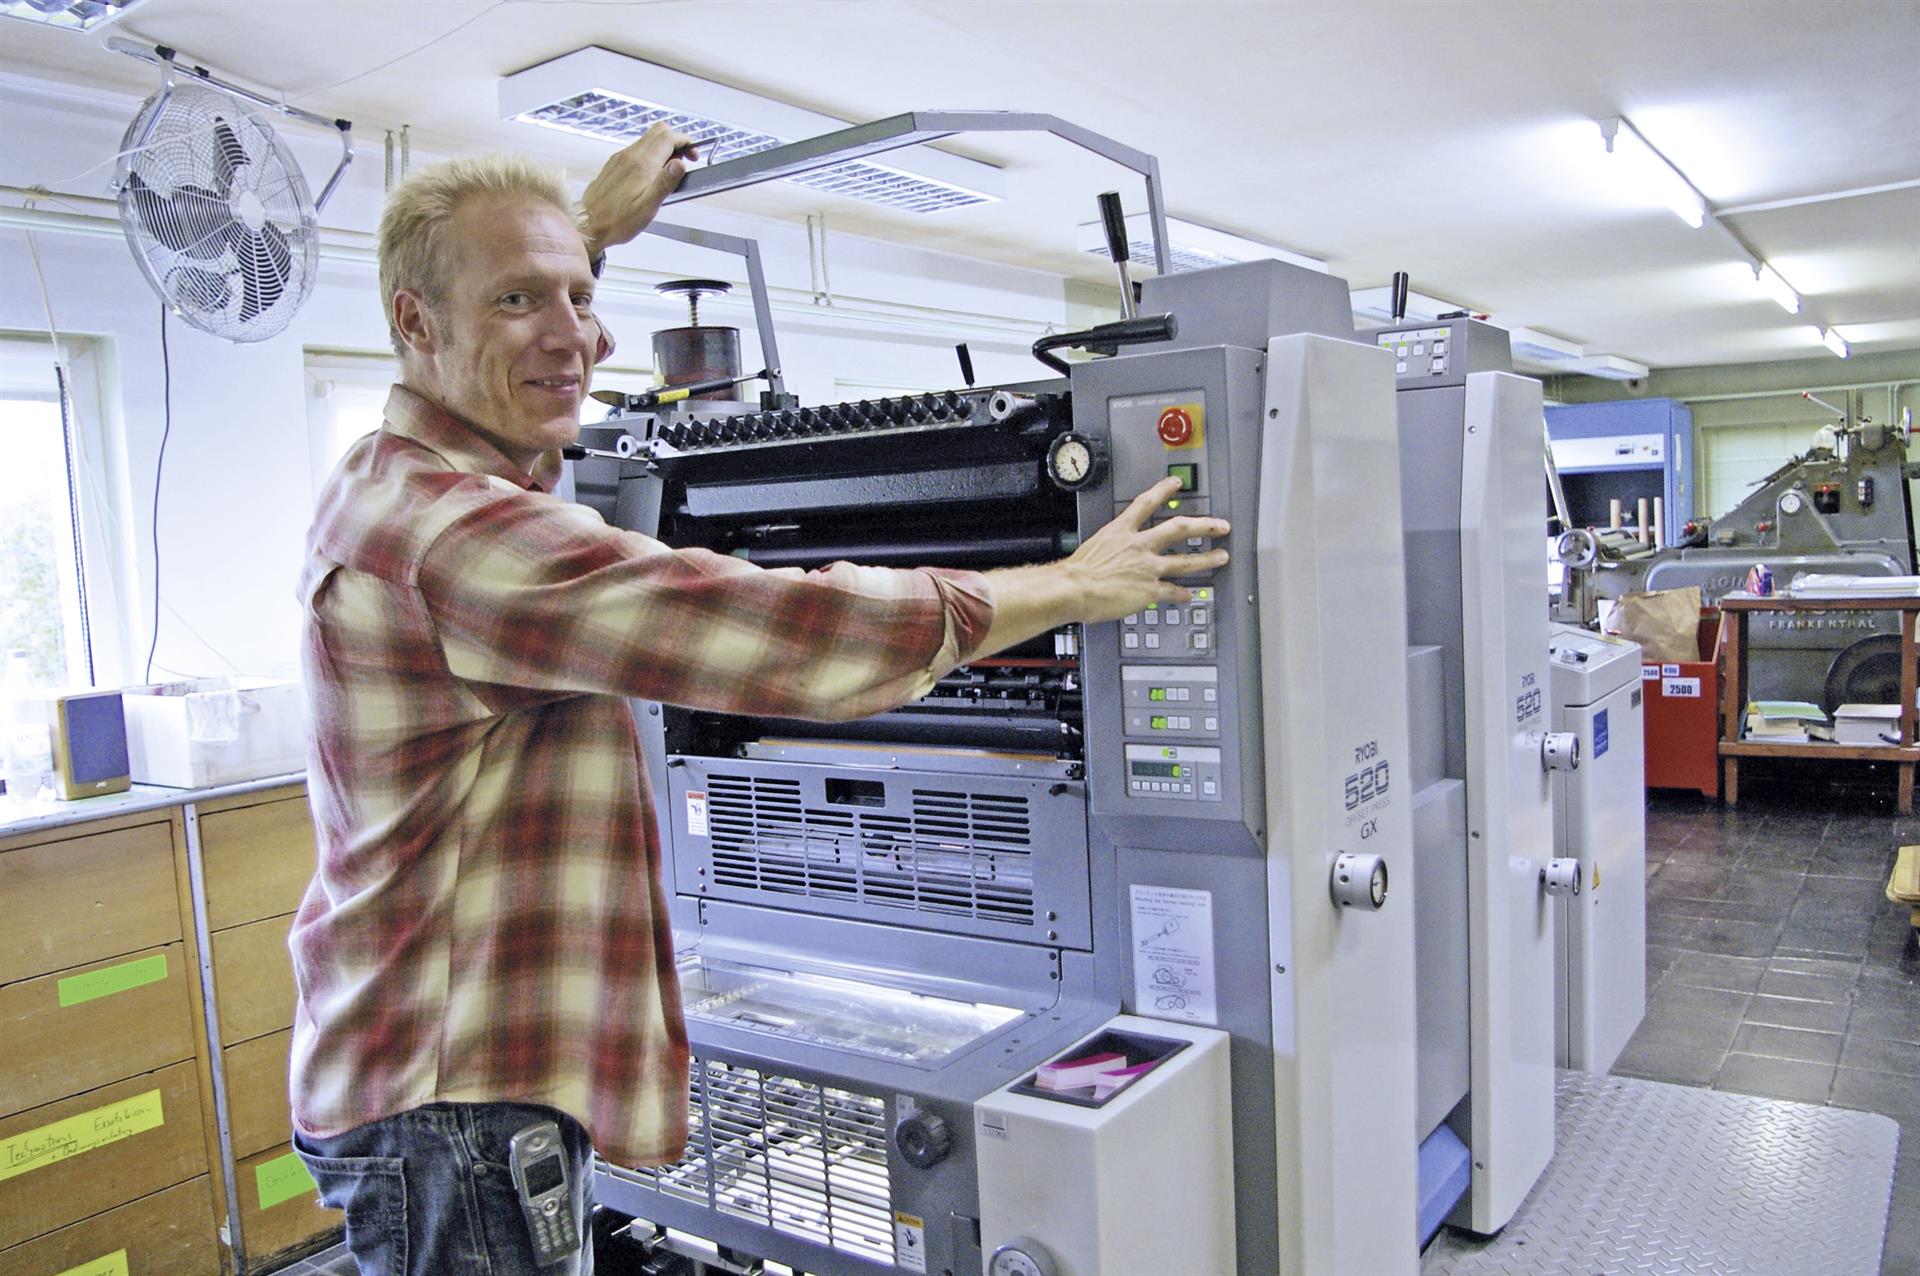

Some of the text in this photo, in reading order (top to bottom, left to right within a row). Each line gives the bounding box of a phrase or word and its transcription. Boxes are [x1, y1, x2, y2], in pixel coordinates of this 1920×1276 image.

[1769, 619, 1876, 629] FRANKENTHAL
[1670, 684, 1693, 695] 2500
[1517, 688, 1541, 722] 520
[1355, 739, 1378, 764] RYOBI
[1345, 760, 1389, 811] 520
[1361, 817, 1377, 840] GX
